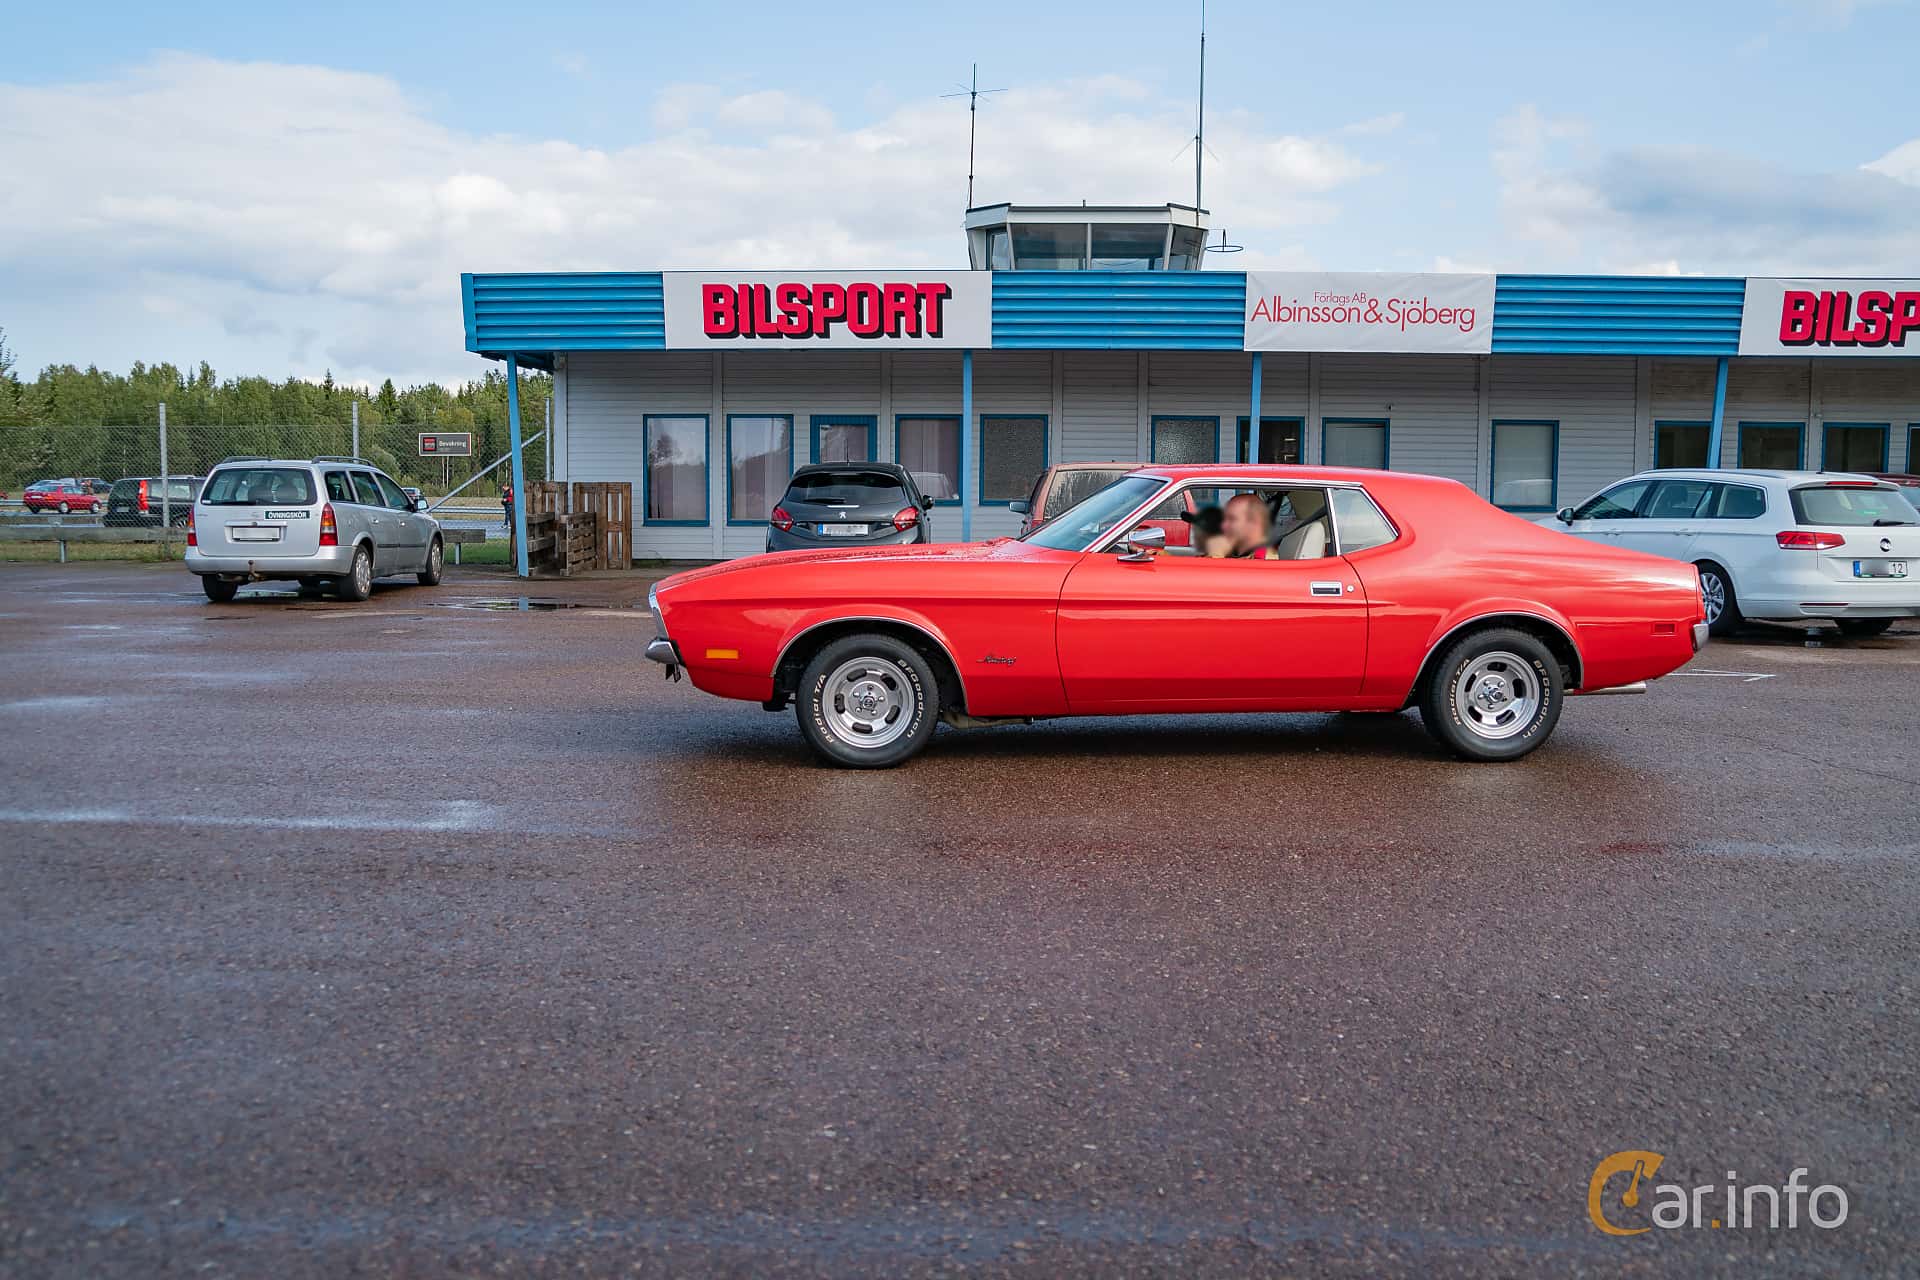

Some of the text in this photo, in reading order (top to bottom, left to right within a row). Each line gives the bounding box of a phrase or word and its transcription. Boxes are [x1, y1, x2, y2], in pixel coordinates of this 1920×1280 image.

[702, 282, 952, 339] BILSPORT
[1314, 292, 1367, 306] Förlags AB
[1779, 290, 1920, 347] BILSP
[267, 511, 307, 520] ÖVNINGSKÖR
[813, 674, 835, 743] Radial T/A
[896, 659, 924, 738] BFGoodrich
[1522, 660, 1550, 738] BFGoodrich
